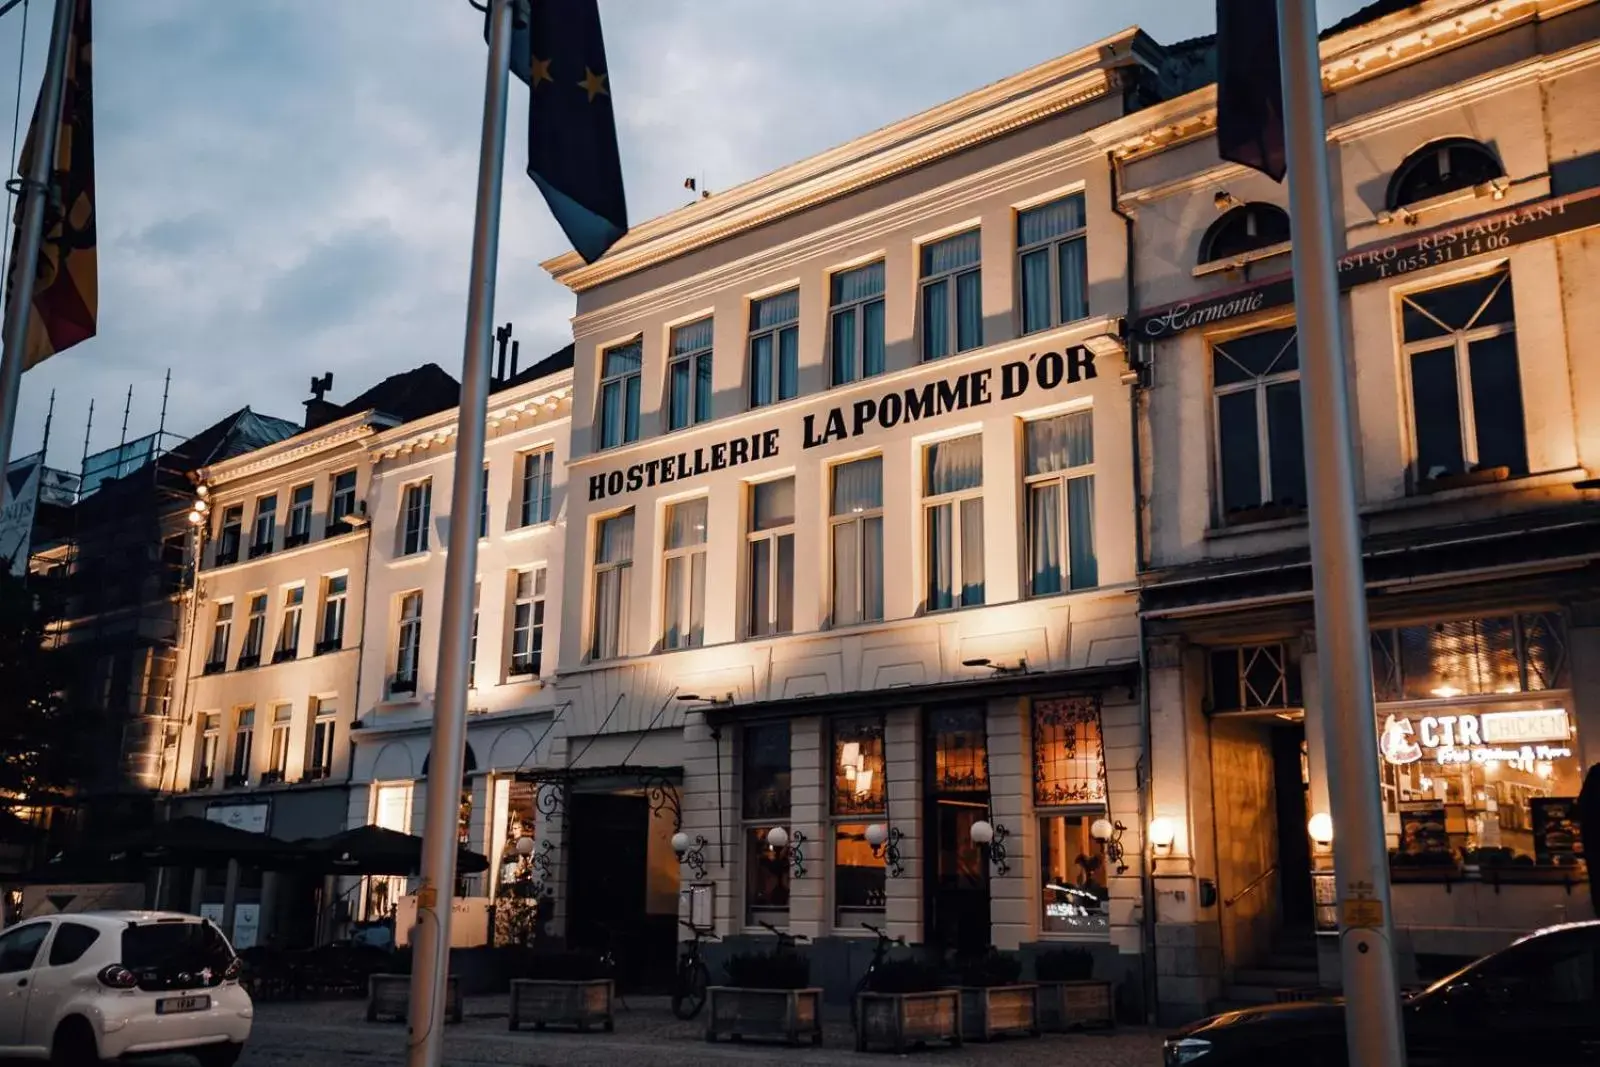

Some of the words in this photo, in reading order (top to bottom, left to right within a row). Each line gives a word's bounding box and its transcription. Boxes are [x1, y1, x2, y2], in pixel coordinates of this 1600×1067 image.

[1337, 245, 1398, 272] ISTRO
[1417, 200, 1567, 250] RESTAURANT
[1377, 263, 1392, 279] T.
[1398, 253, 1428, 273] 055
[1435, 247, 1454, 263] 31
[1462, 240, 1481, 257] 14
[1487, 233, 1510, 249] 06
[1146, 292, 1263, 334] Harmonie
[588, 428, 779, 501] HOSTELLERIE
[1421, 715, 1481, 747] CTR
[1487, 715, 1564, 737] CHICKEN
